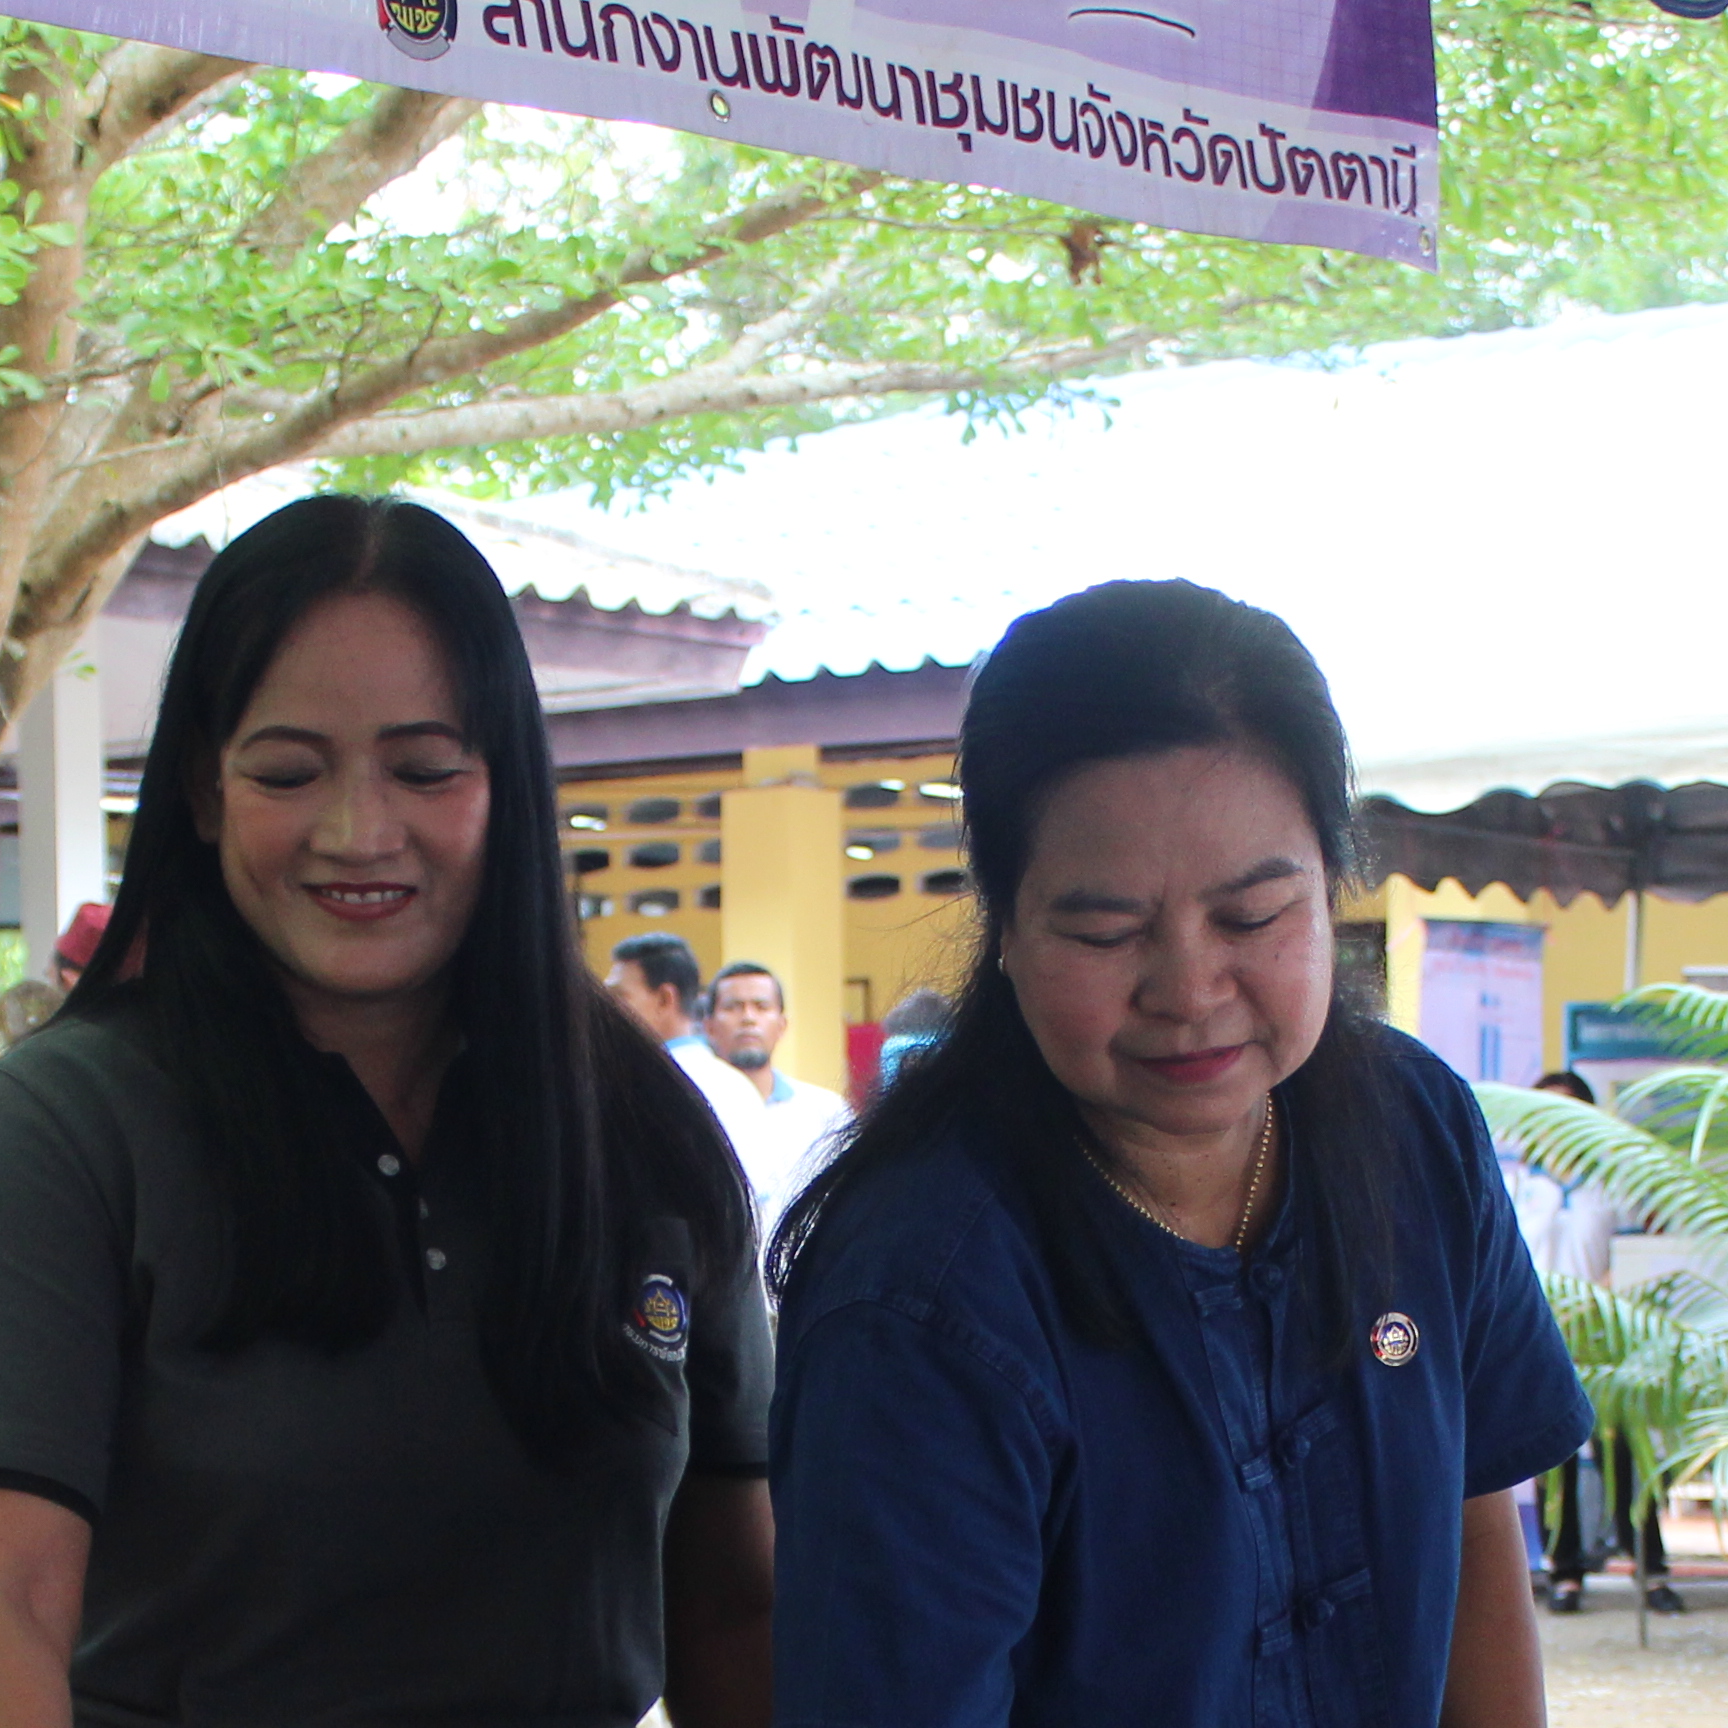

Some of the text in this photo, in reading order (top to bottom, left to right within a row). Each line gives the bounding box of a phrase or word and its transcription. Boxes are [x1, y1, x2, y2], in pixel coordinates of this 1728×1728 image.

[483, 0, 1419, 216] สำนกงานพัฒนาชุมชนจังหวัดปัตตานี
